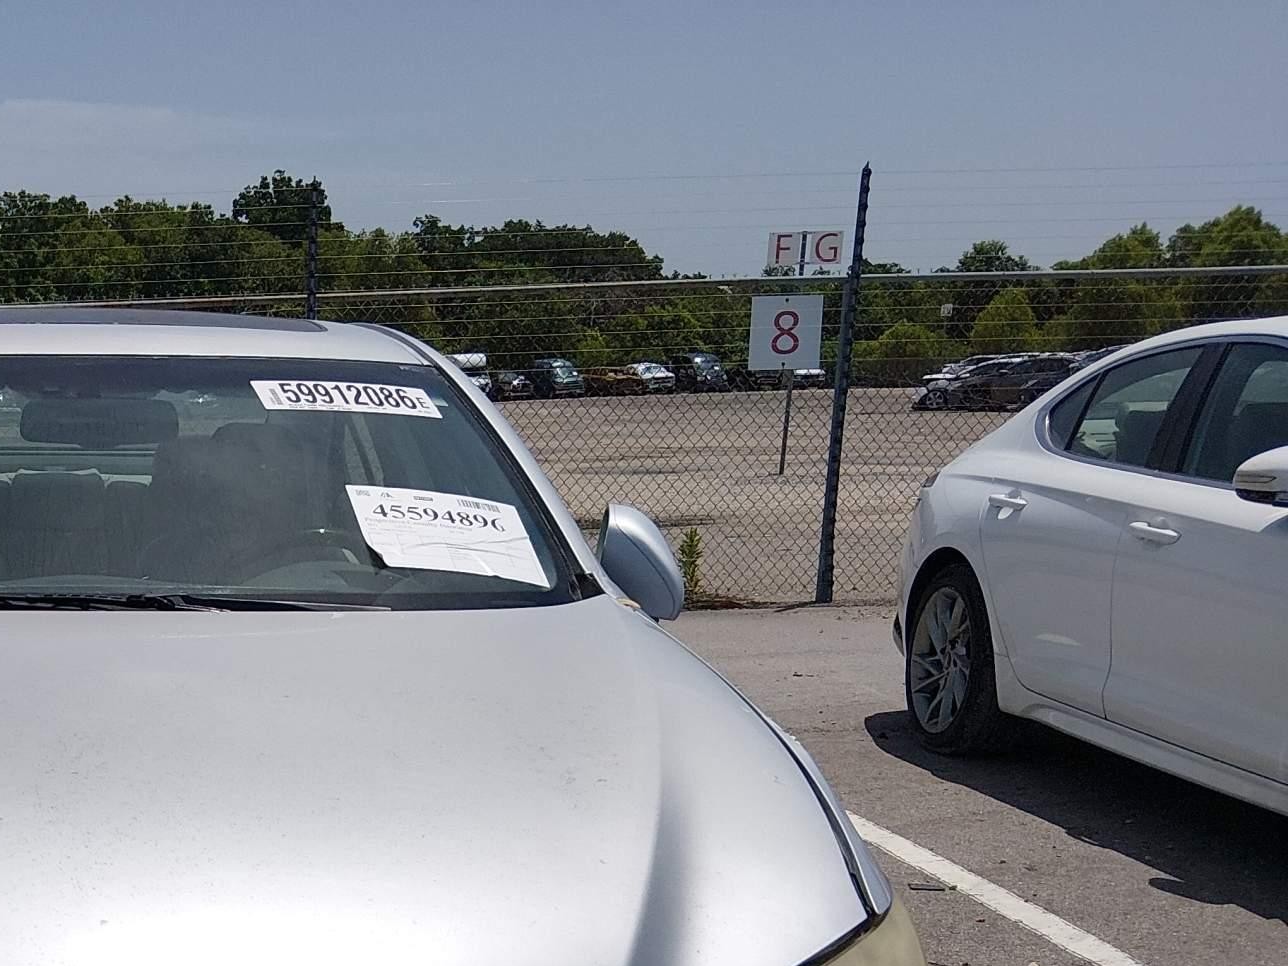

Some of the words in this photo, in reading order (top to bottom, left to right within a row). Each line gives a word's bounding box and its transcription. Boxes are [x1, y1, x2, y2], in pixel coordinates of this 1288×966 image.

[775, 234, 793, 264] F
[815, 233, 839, 262] G
[772, 310, 799, 354] 8
[279, 383, 416, 410] 59912086
[372, 503, 505, 533] 45594896
